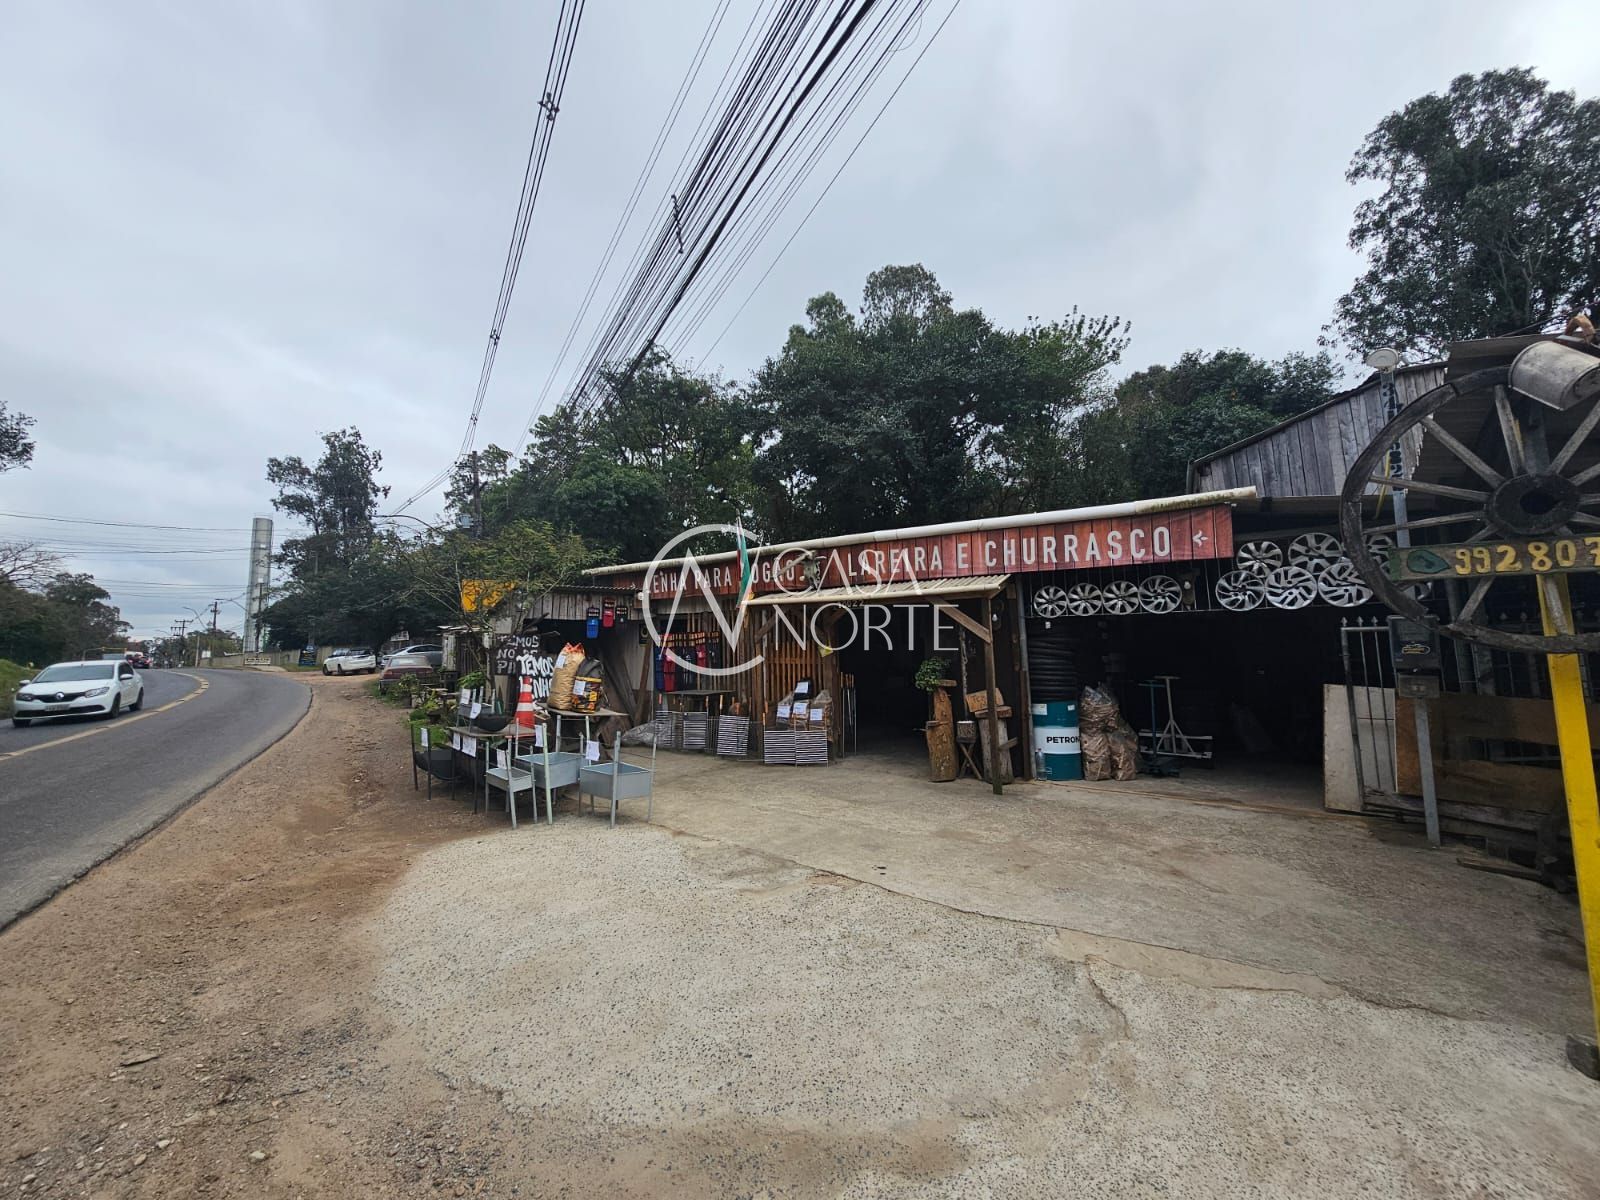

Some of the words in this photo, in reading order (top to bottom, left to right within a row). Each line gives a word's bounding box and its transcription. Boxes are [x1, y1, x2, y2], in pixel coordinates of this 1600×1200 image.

[695, 566, 732, 589] PARA
[847, 545, 943, 577] LAREIRA
[957, 543, 969, 569] E
[984, 526, 1171, 568] CHURRASCO
